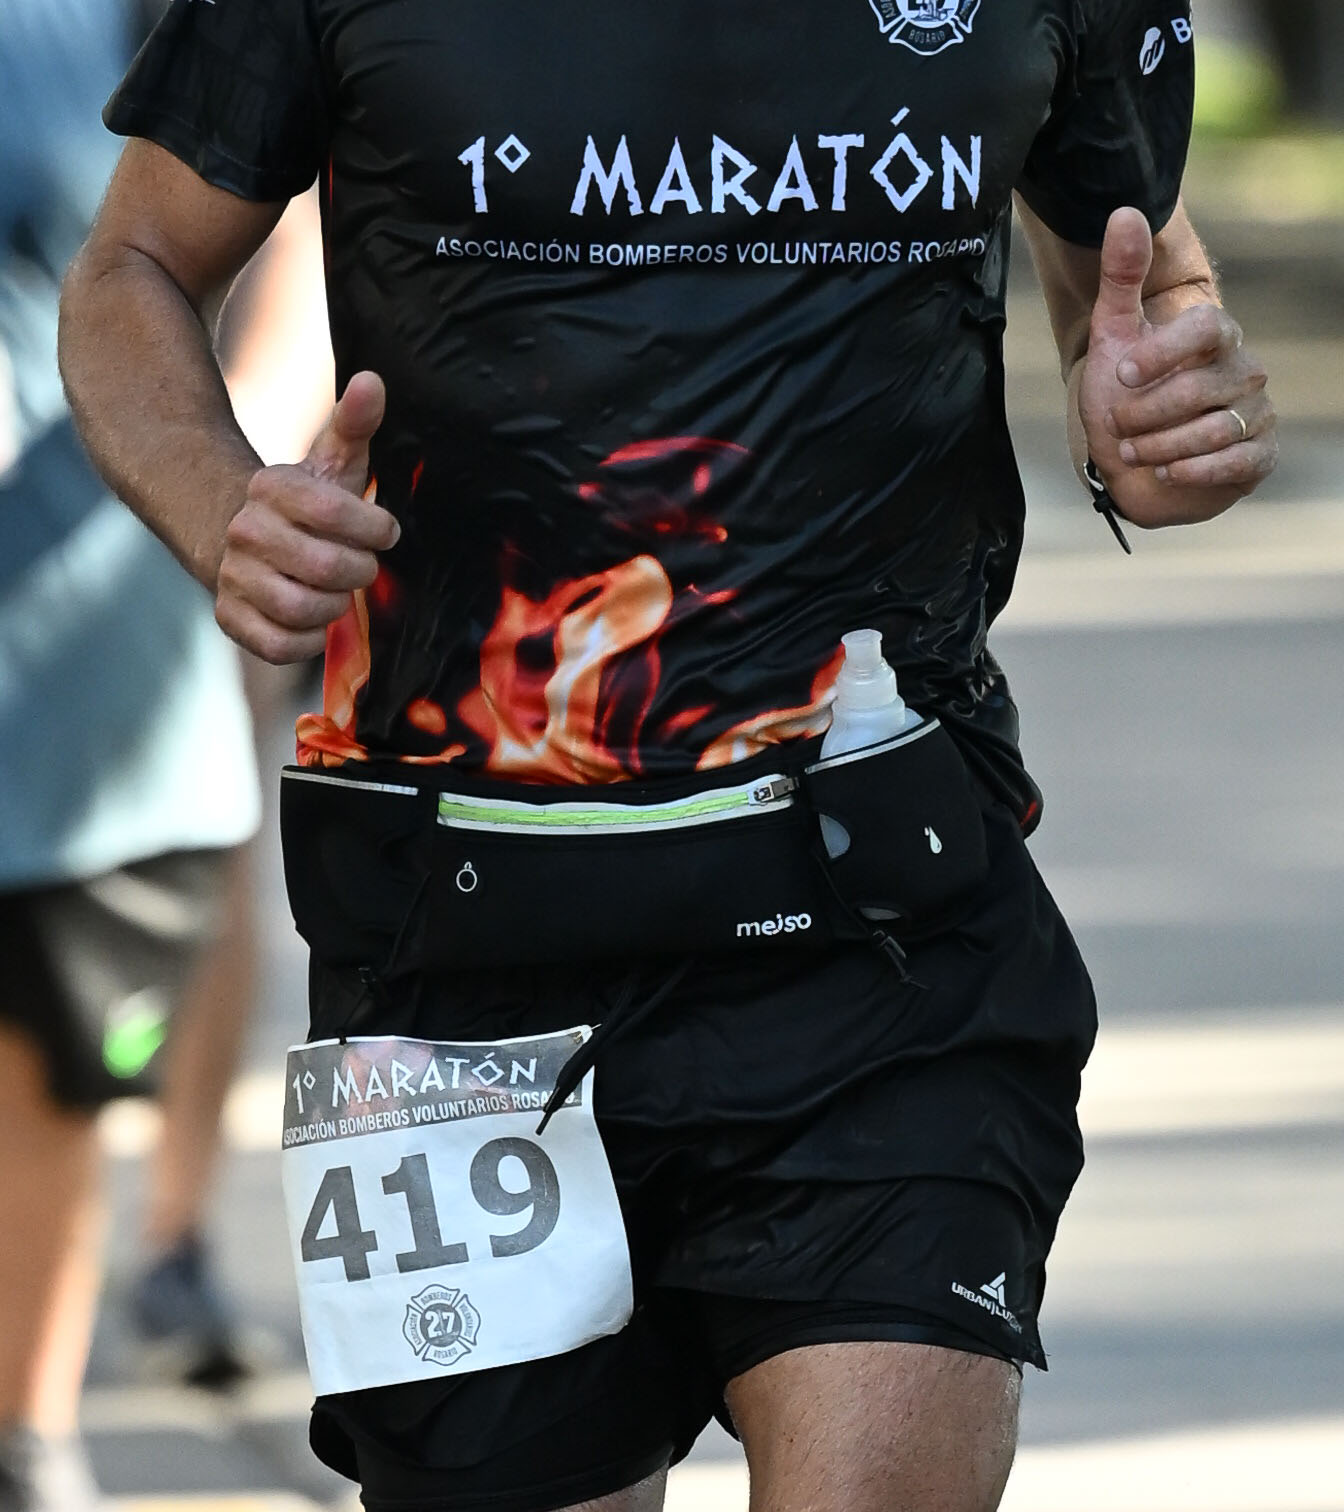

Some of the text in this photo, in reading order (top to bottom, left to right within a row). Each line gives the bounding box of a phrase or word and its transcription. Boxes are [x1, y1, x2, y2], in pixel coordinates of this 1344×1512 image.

[569, 106, 982, 217] MARATÓN
[435, 236, 580, 263] ASOCIACIÓN
[588, 243, 728, 266] BOMBEROS
[736, 241, 902, 264] VOLUNTARIOS
[332, 1052, 538, 1108] MARATÓN
[339, 1108, 410, 1136] BOMBEROS
[412, 1096, 509, 1124] VOLUNTARIOS
[512, 1090, 575, 1110] ROSA
[301, 1136, 561, 1283] 419
[424, 1310, 456, 1339] 27
